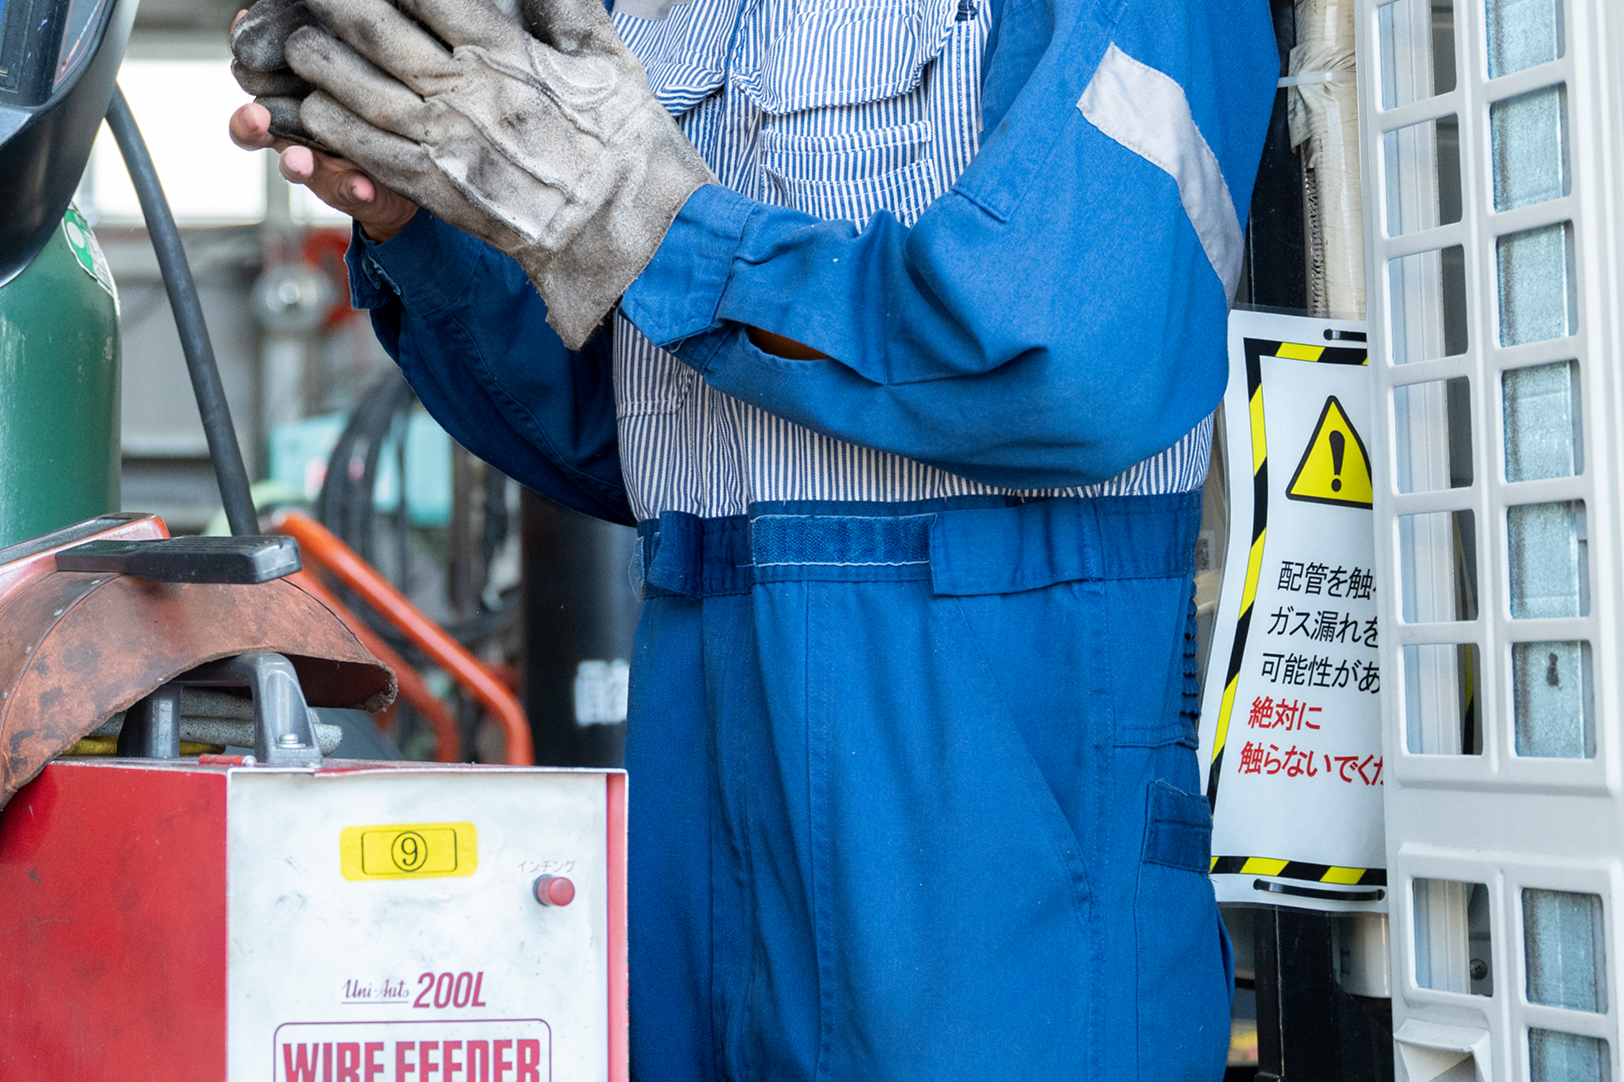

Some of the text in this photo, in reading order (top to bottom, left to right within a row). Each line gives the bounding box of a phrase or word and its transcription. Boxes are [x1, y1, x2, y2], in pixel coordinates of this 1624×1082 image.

[1277, 560, 1377, 601] 配管を触
[1267, 605, 1379, 649] ガス漏れを
[1261, 652, 1381, 694] 可能性があ
[1247, 695, 1323, 731] 絶対に
[517, 860, 576, 873] インチング
[413, 971, 487, 1009] 200L
[282, 1038, 541, 1082] WIRE FEEDER
